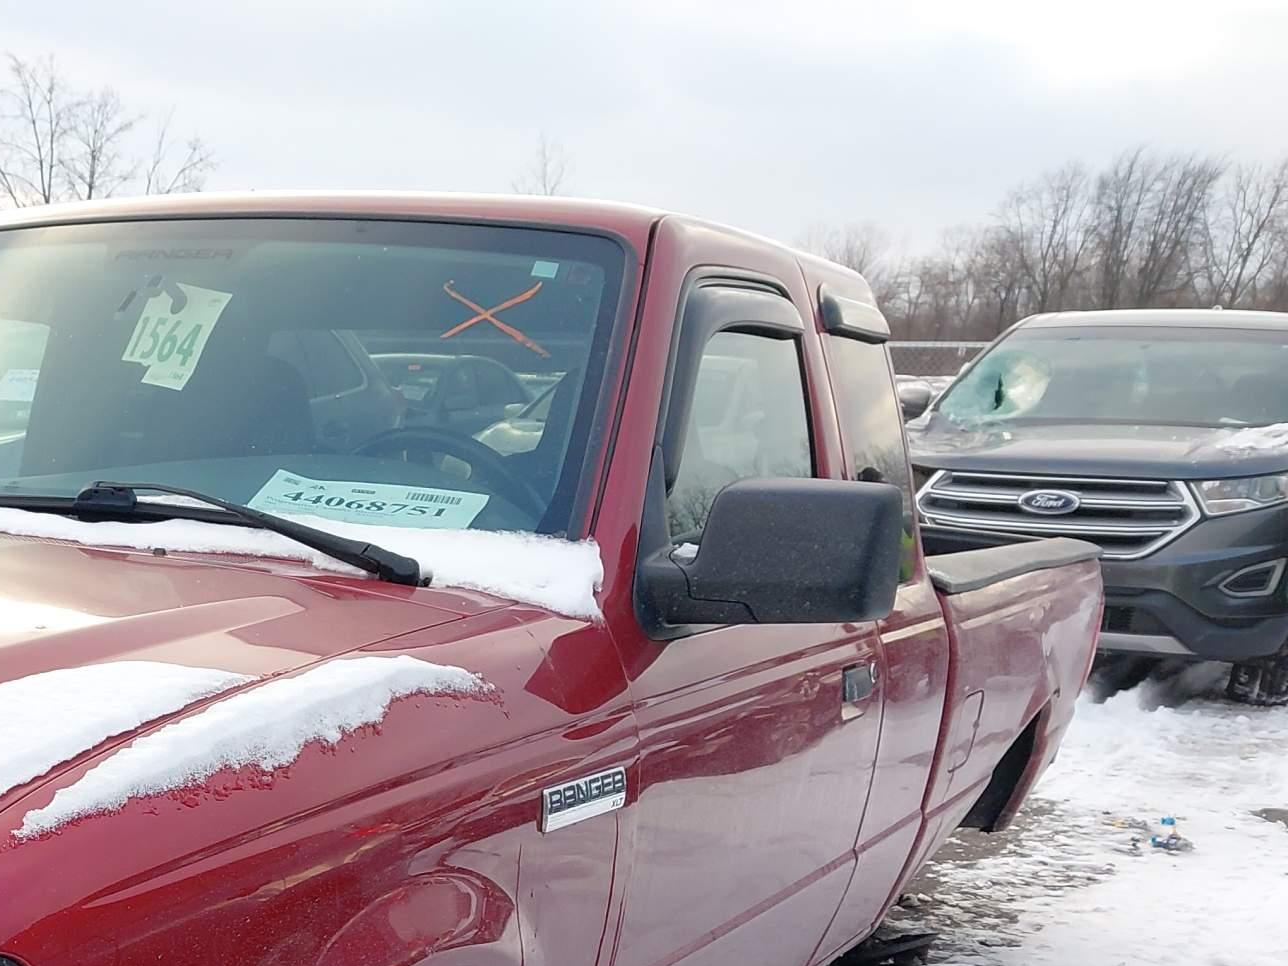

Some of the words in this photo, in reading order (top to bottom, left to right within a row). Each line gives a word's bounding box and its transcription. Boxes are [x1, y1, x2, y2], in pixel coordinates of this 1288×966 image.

[130, 316, 203, 367] 1564
[282, 491, 447, 518] 44068751
[1032, 493, 1065, 508] Ford
[548, 770, 625, 815] RANGER
